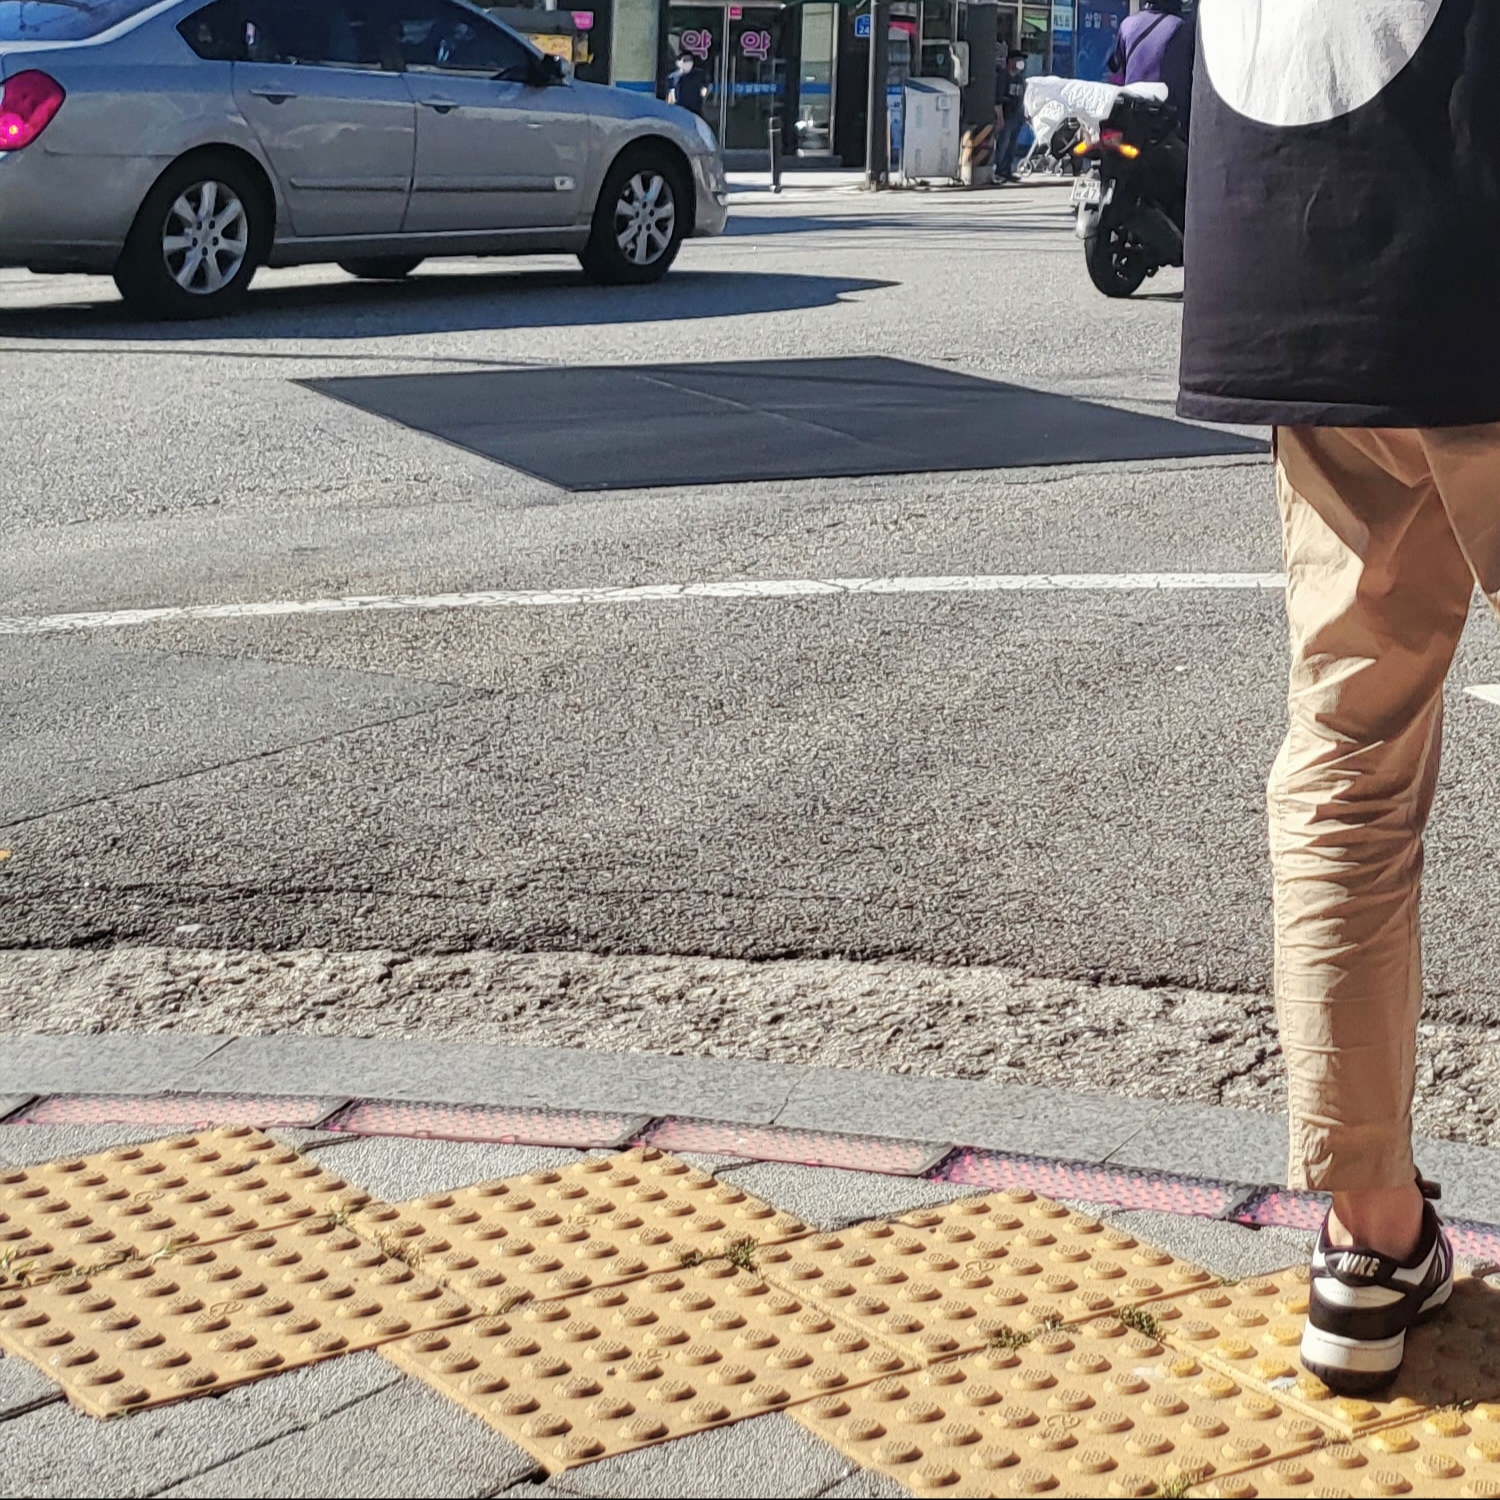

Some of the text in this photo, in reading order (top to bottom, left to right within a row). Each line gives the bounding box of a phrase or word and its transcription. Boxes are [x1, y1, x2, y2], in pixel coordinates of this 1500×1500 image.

[681, 29, 713, 61] 약
[740, 30, 771, 62] 약
[1335, 1250, 1382, 1278] NIKE
